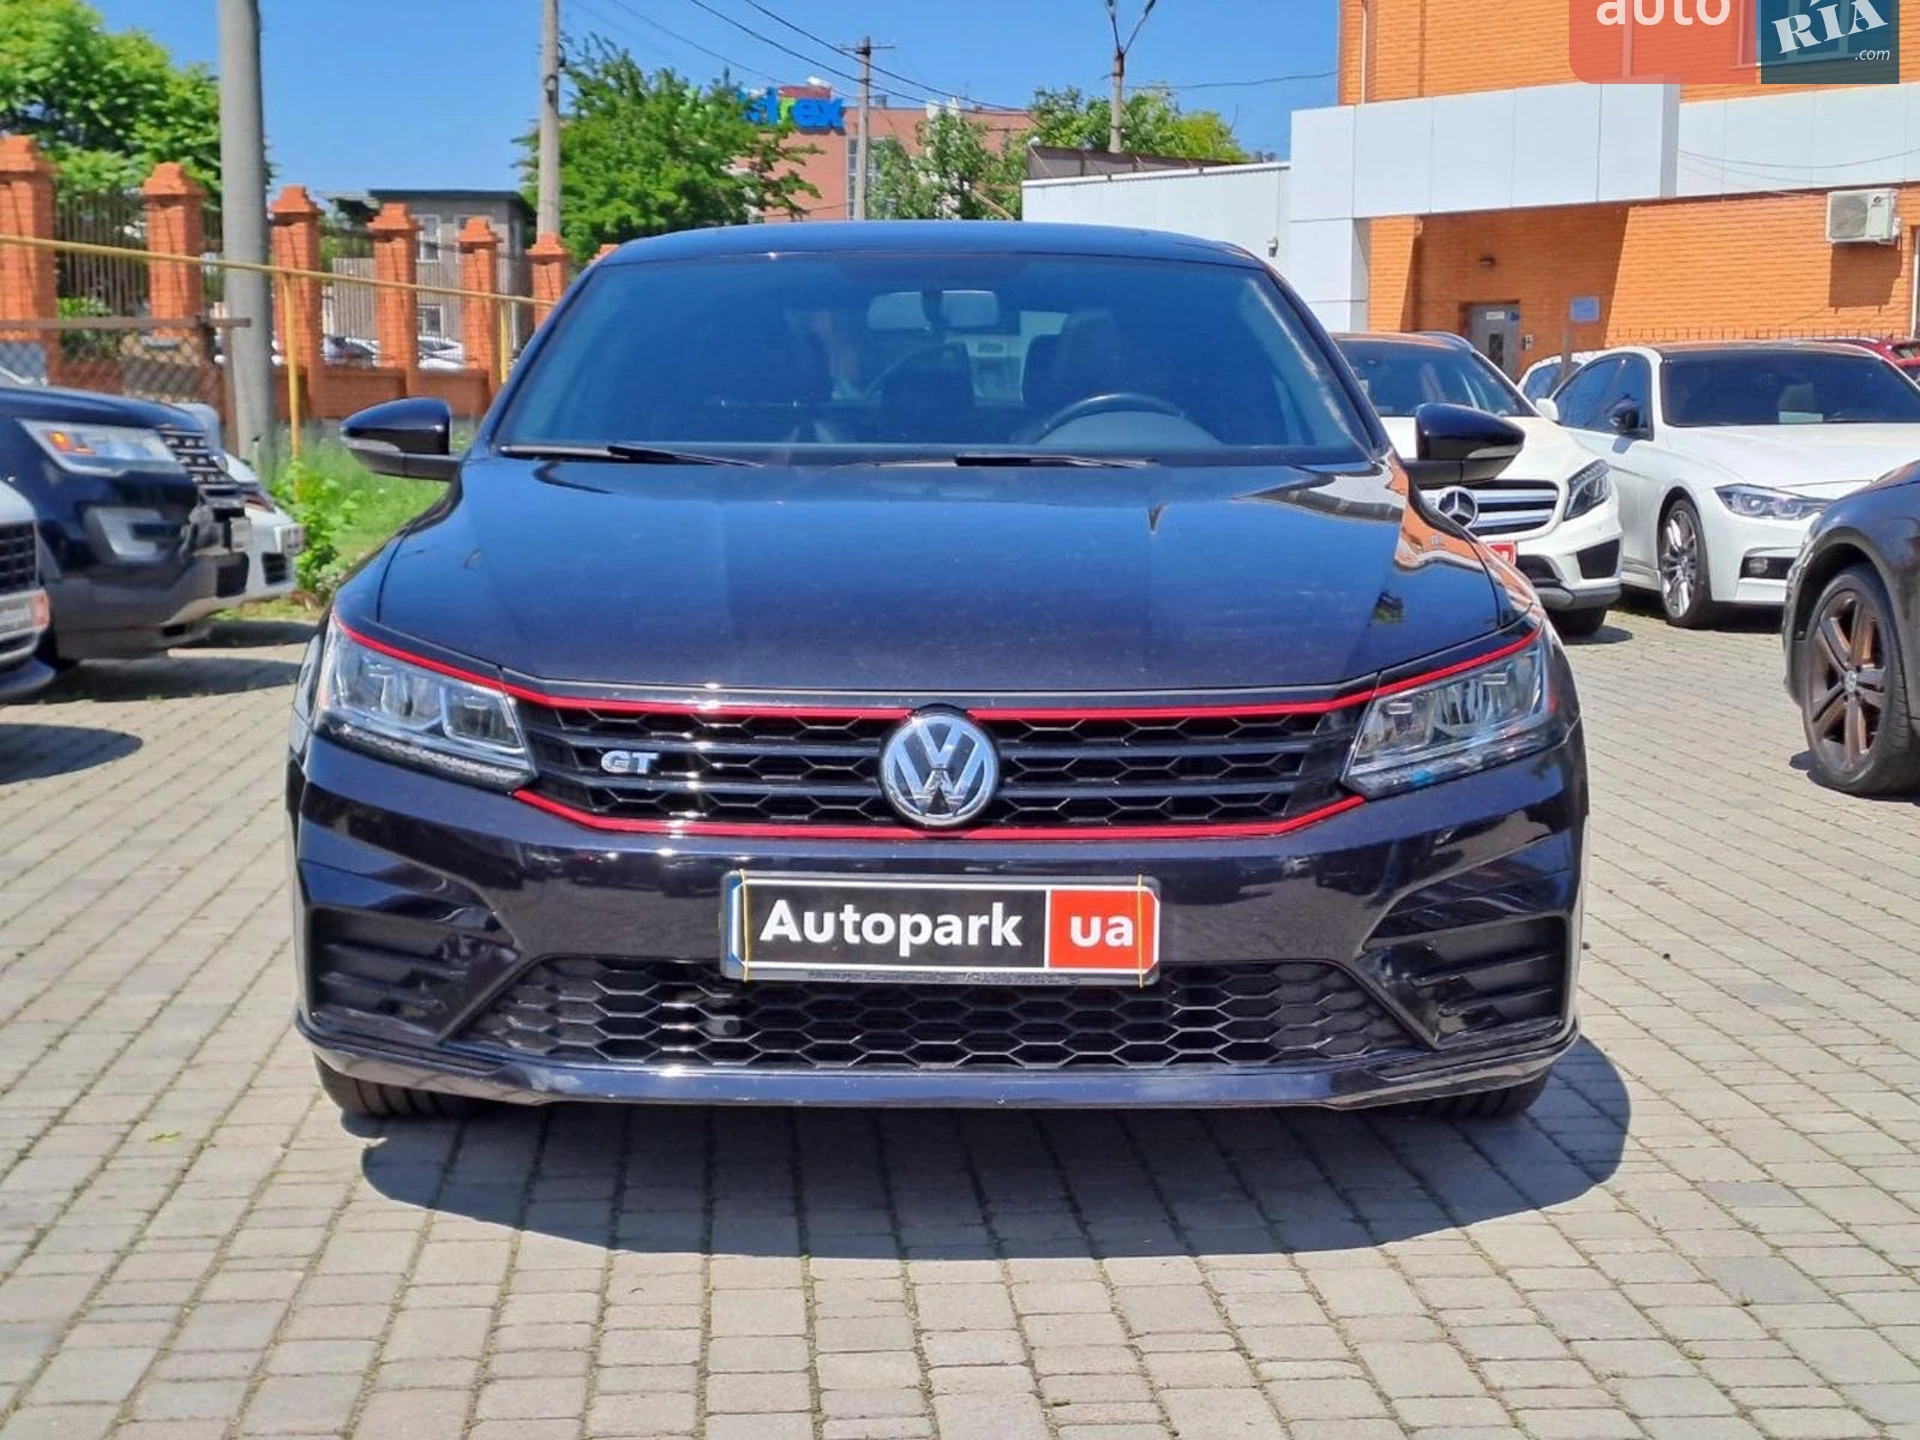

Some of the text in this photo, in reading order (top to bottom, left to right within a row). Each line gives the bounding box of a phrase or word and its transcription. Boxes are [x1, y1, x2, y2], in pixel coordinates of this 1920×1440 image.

[600, 750, 659, 775] GT
[759, 899, 1134, 957] Autopark ua
